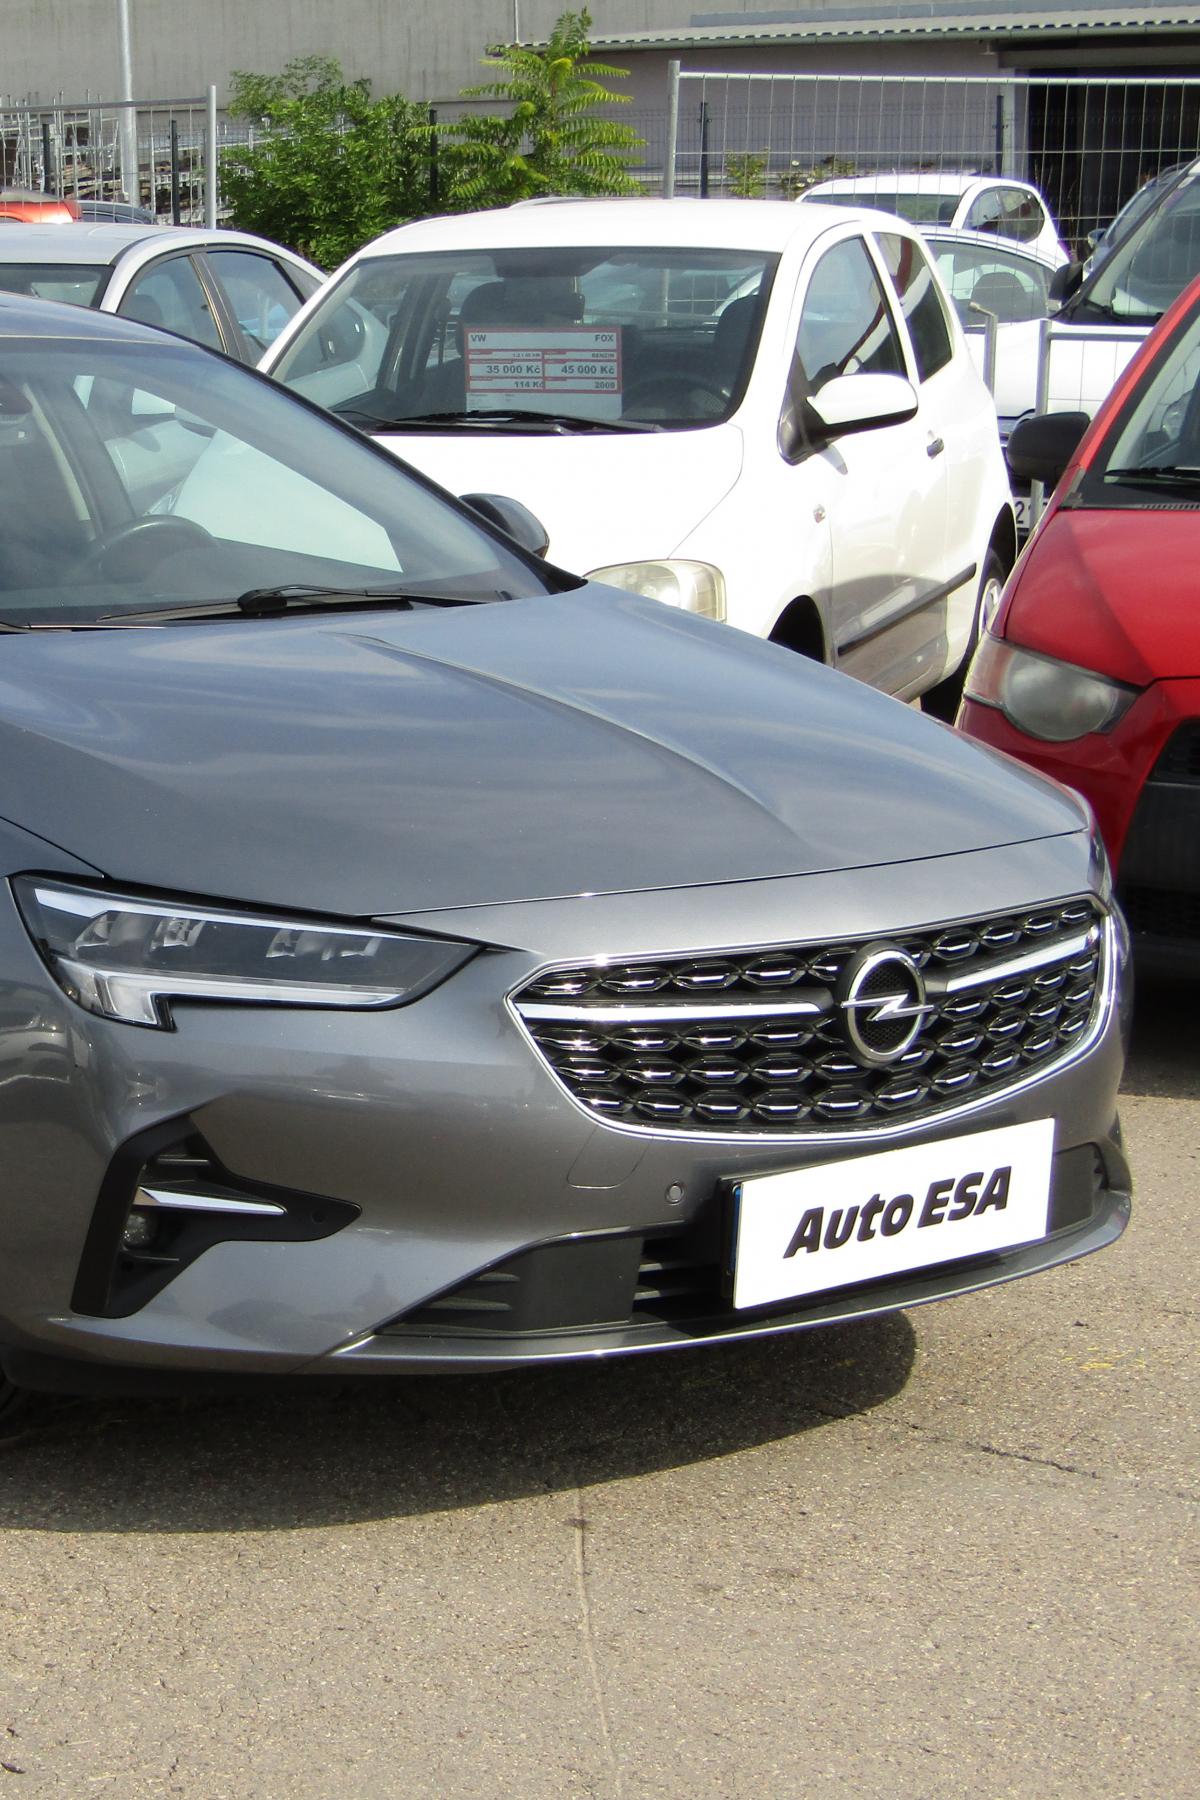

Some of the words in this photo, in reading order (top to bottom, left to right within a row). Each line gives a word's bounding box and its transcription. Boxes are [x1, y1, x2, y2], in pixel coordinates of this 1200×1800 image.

[470, 334, 487, 342] VW
[595, 334, 614, 342] FOX
[486, 365, 500, 374] 35
[503, 365, 523, 374] 000
[526, 364, 541, 374] Kč
[561, 365, 575, 374] 45
[577, 365, 597, 374] 000
[600, 365, 615, 374] Kč
[783, 1194, 914, 1259] Auto
[917, 1166, 1012, 1229] ESA
